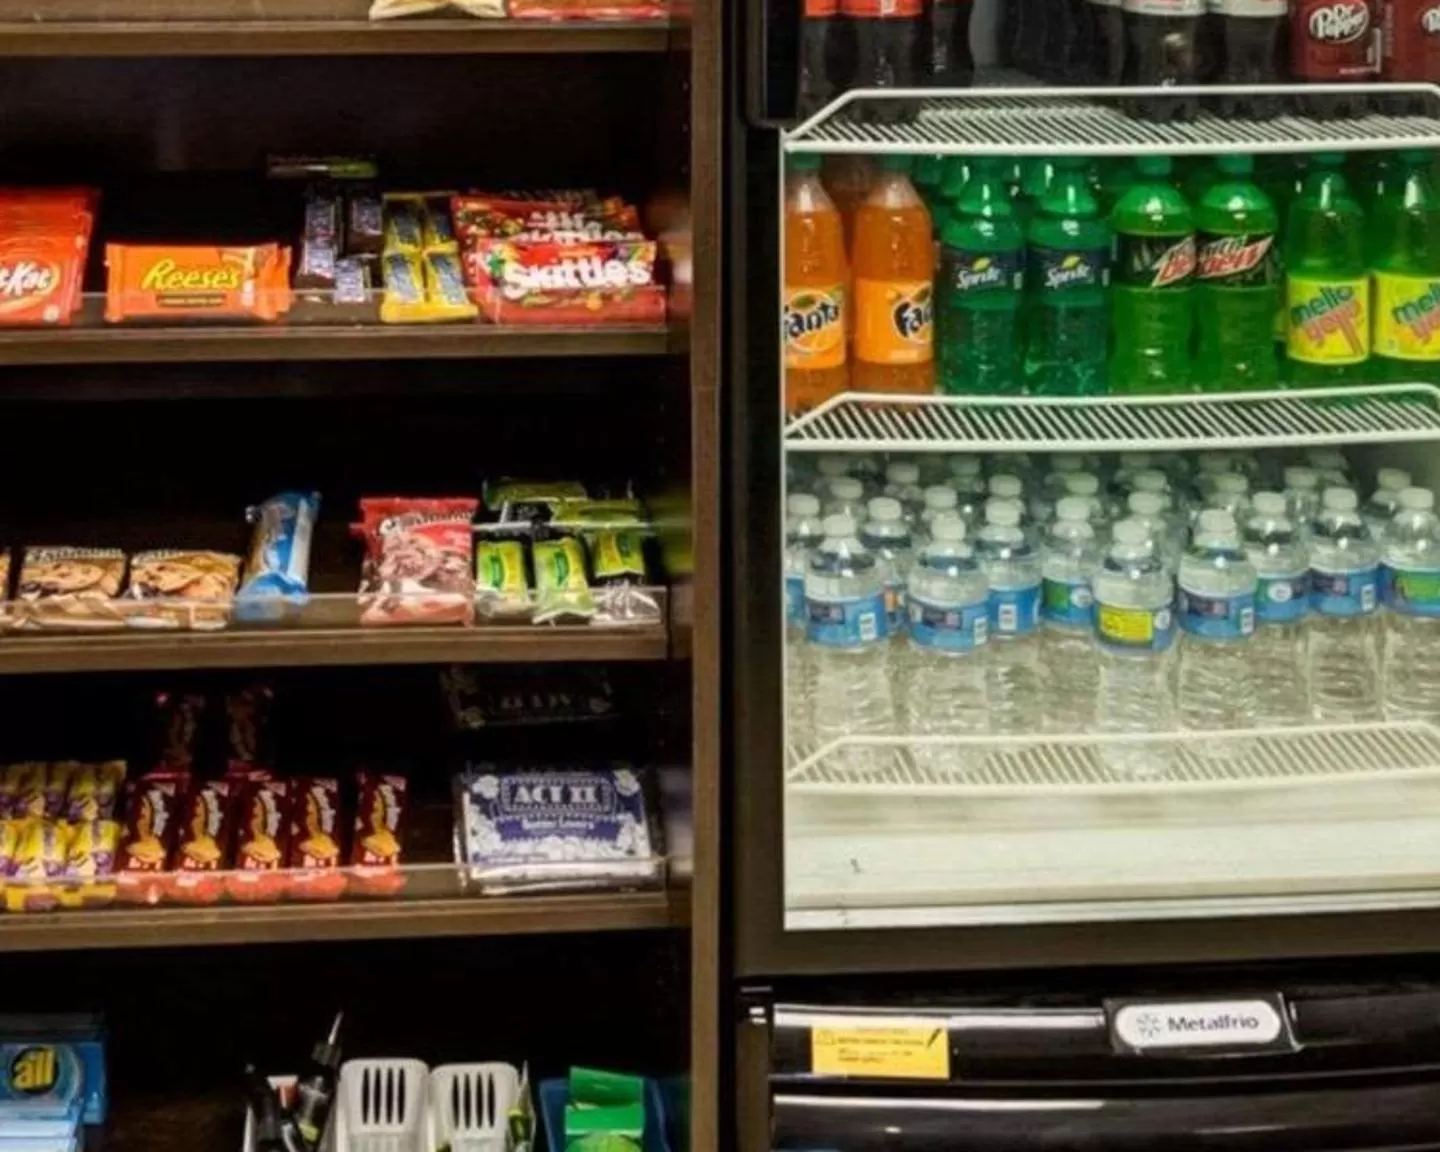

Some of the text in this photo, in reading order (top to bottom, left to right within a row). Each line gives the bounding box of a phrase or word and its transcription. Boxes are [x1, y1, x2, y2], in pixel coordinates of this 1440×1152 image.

[504, 249, 655, 299] Skittles
[784, 301, 839, 338] anta
[1167, 1014, 1260, 1032] Metalfrio
[13, 1048, 55, 1088] all
